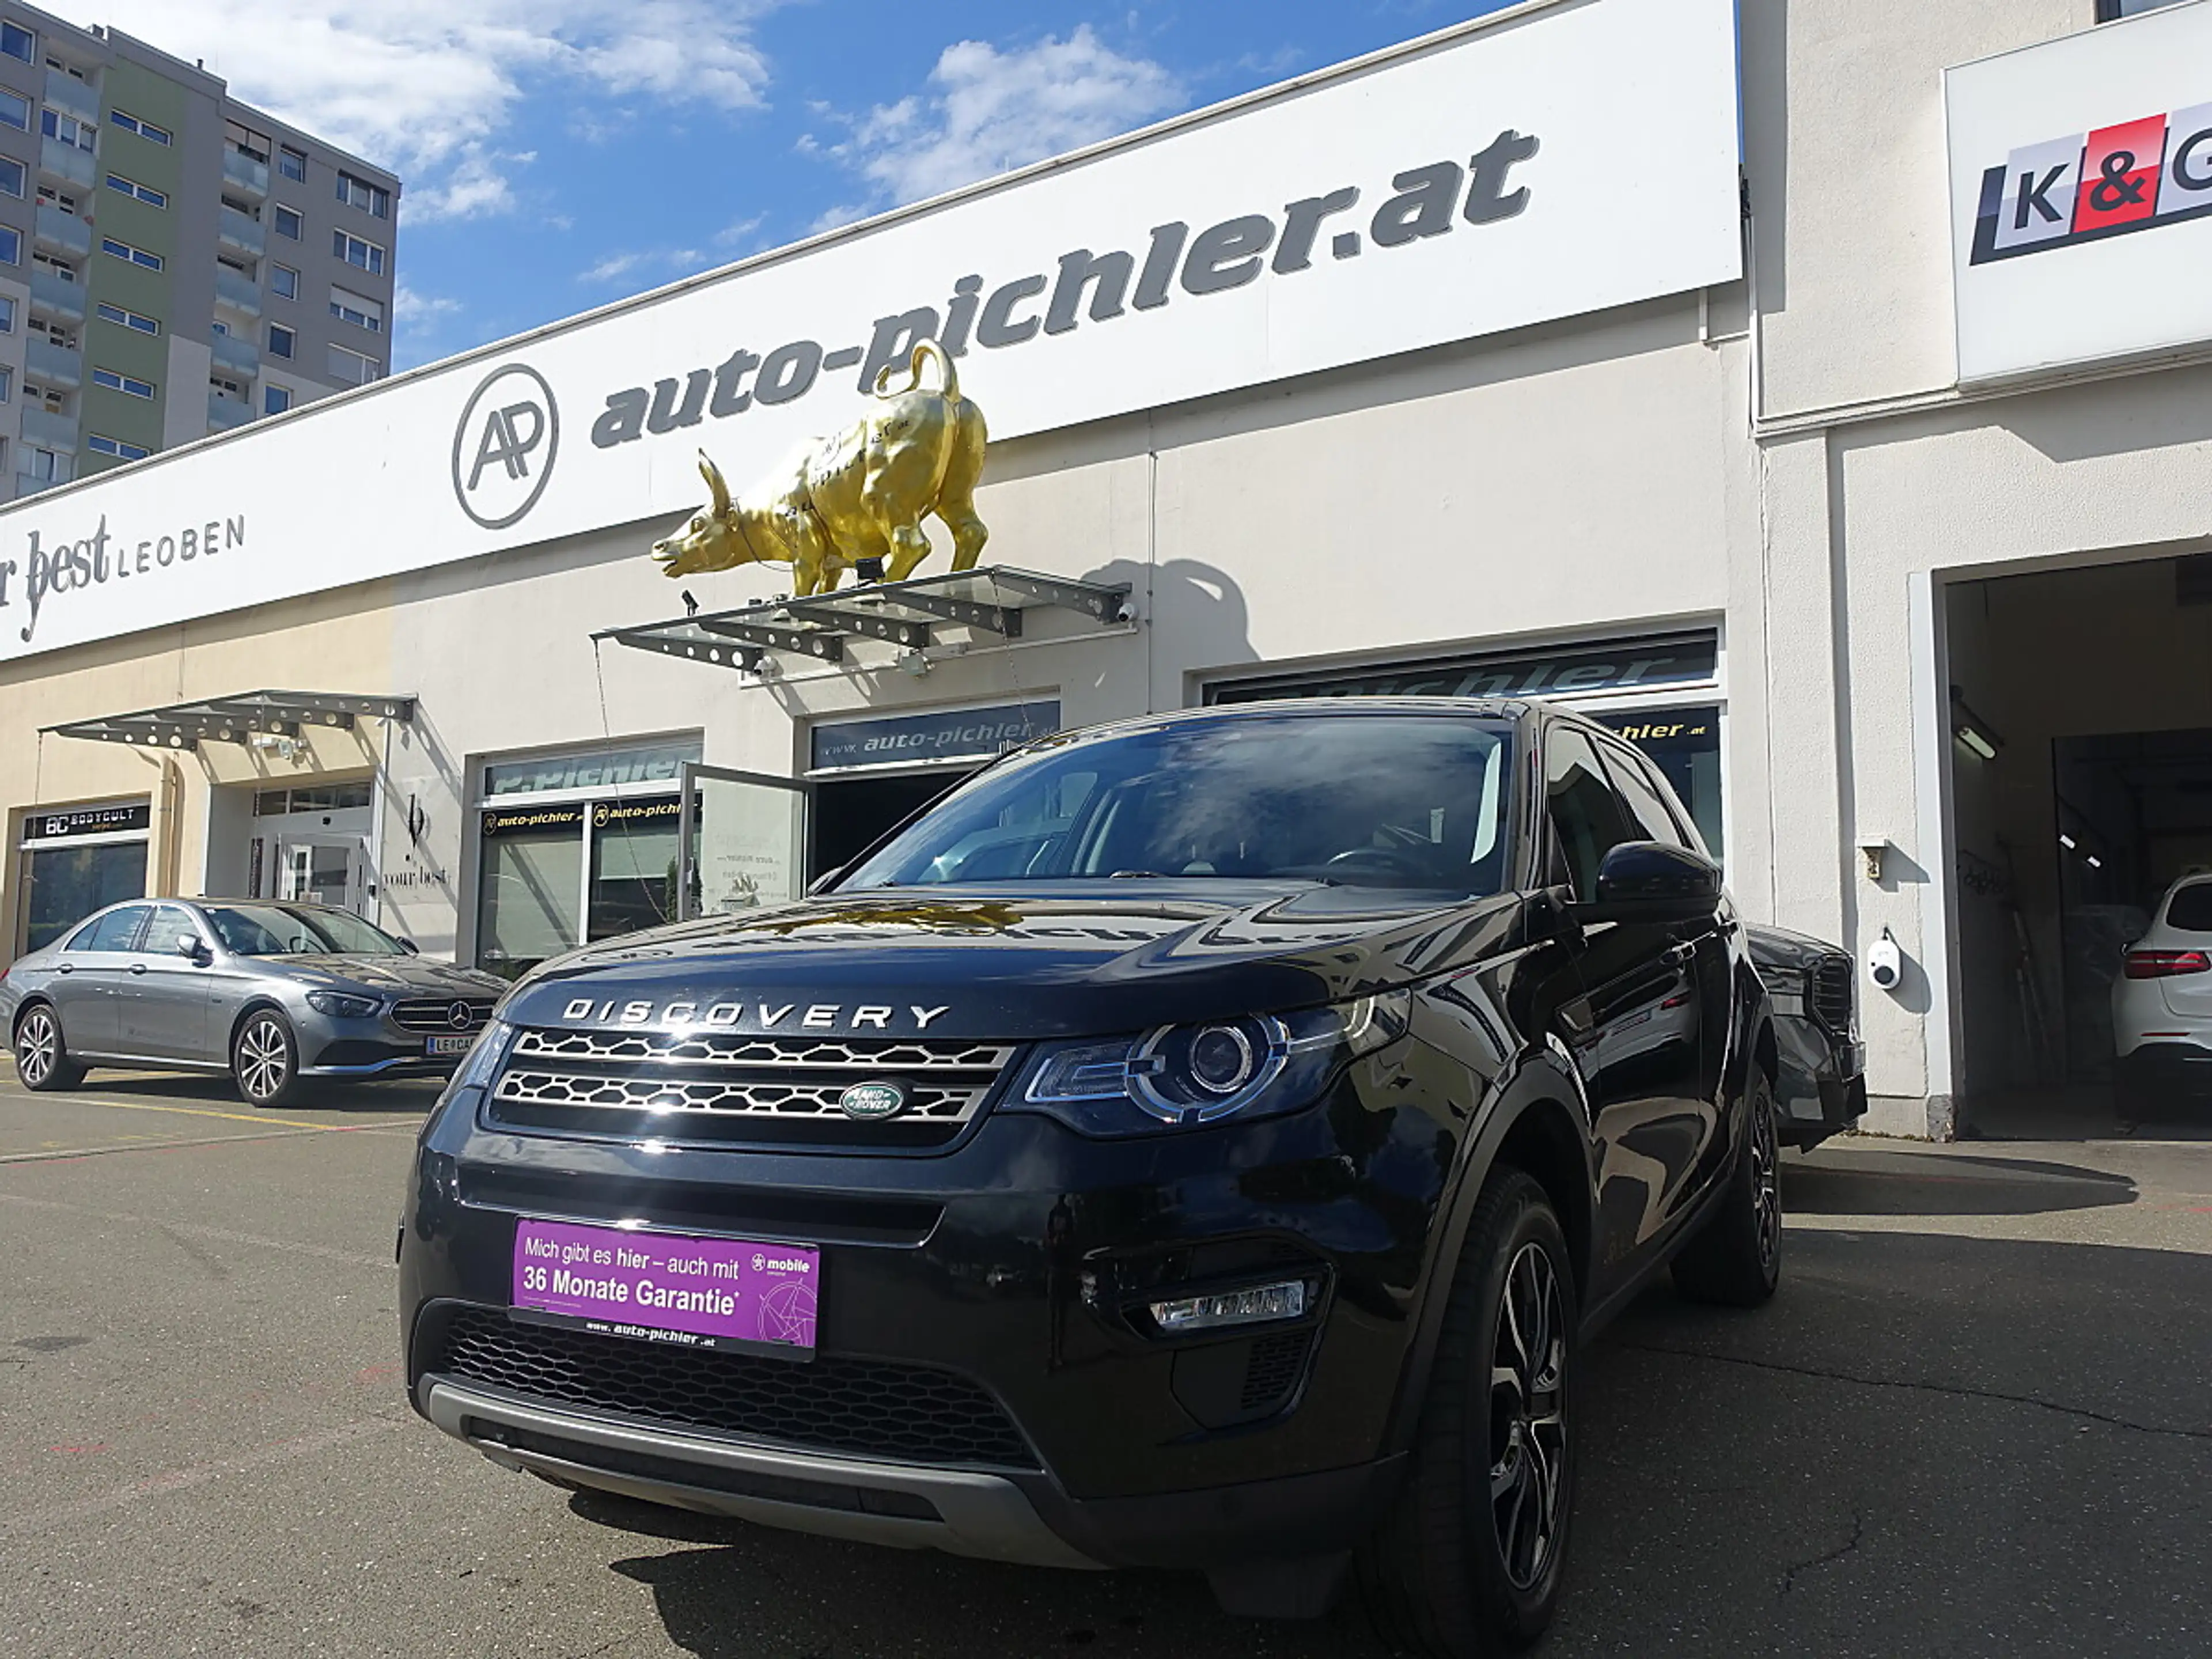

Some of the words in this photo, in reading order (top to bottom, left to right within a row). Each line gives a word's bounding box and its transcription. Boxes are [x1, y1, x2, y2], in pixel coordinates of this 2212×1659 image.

[590, 129, 1539, 449] auto-pichler.at
[21, 513, 111, 643] best
[118, 514, 244, 578] LEOBEN
[864, 721, 1035, 751] auto-pichler
[1686, 726, 1706, 735] .at
[70, 809, 134, 825] BODYCULT
[497, 812, 575, 827] auto-pichler
[609, 803, 681, 818] auto-pichl
[562, 998, 951, 1030] DISCOVERY
[525, 1237, 559, 1258] Mich
[562, 1242, 590, 1265] gibt
[593, 1249, 611, 1266] es
[616, 1247, 650, 1270] hier
[666, 1256, 708, 1277] auch
[713, 1259, 740, 1280] mit
[767, 1258, 810, 1274] mobile
[523, 1266, 547, 1291] 36
[552, 1269, 629, 1303] Monate
[613, 1324, 699, 1345] auto-pichler
